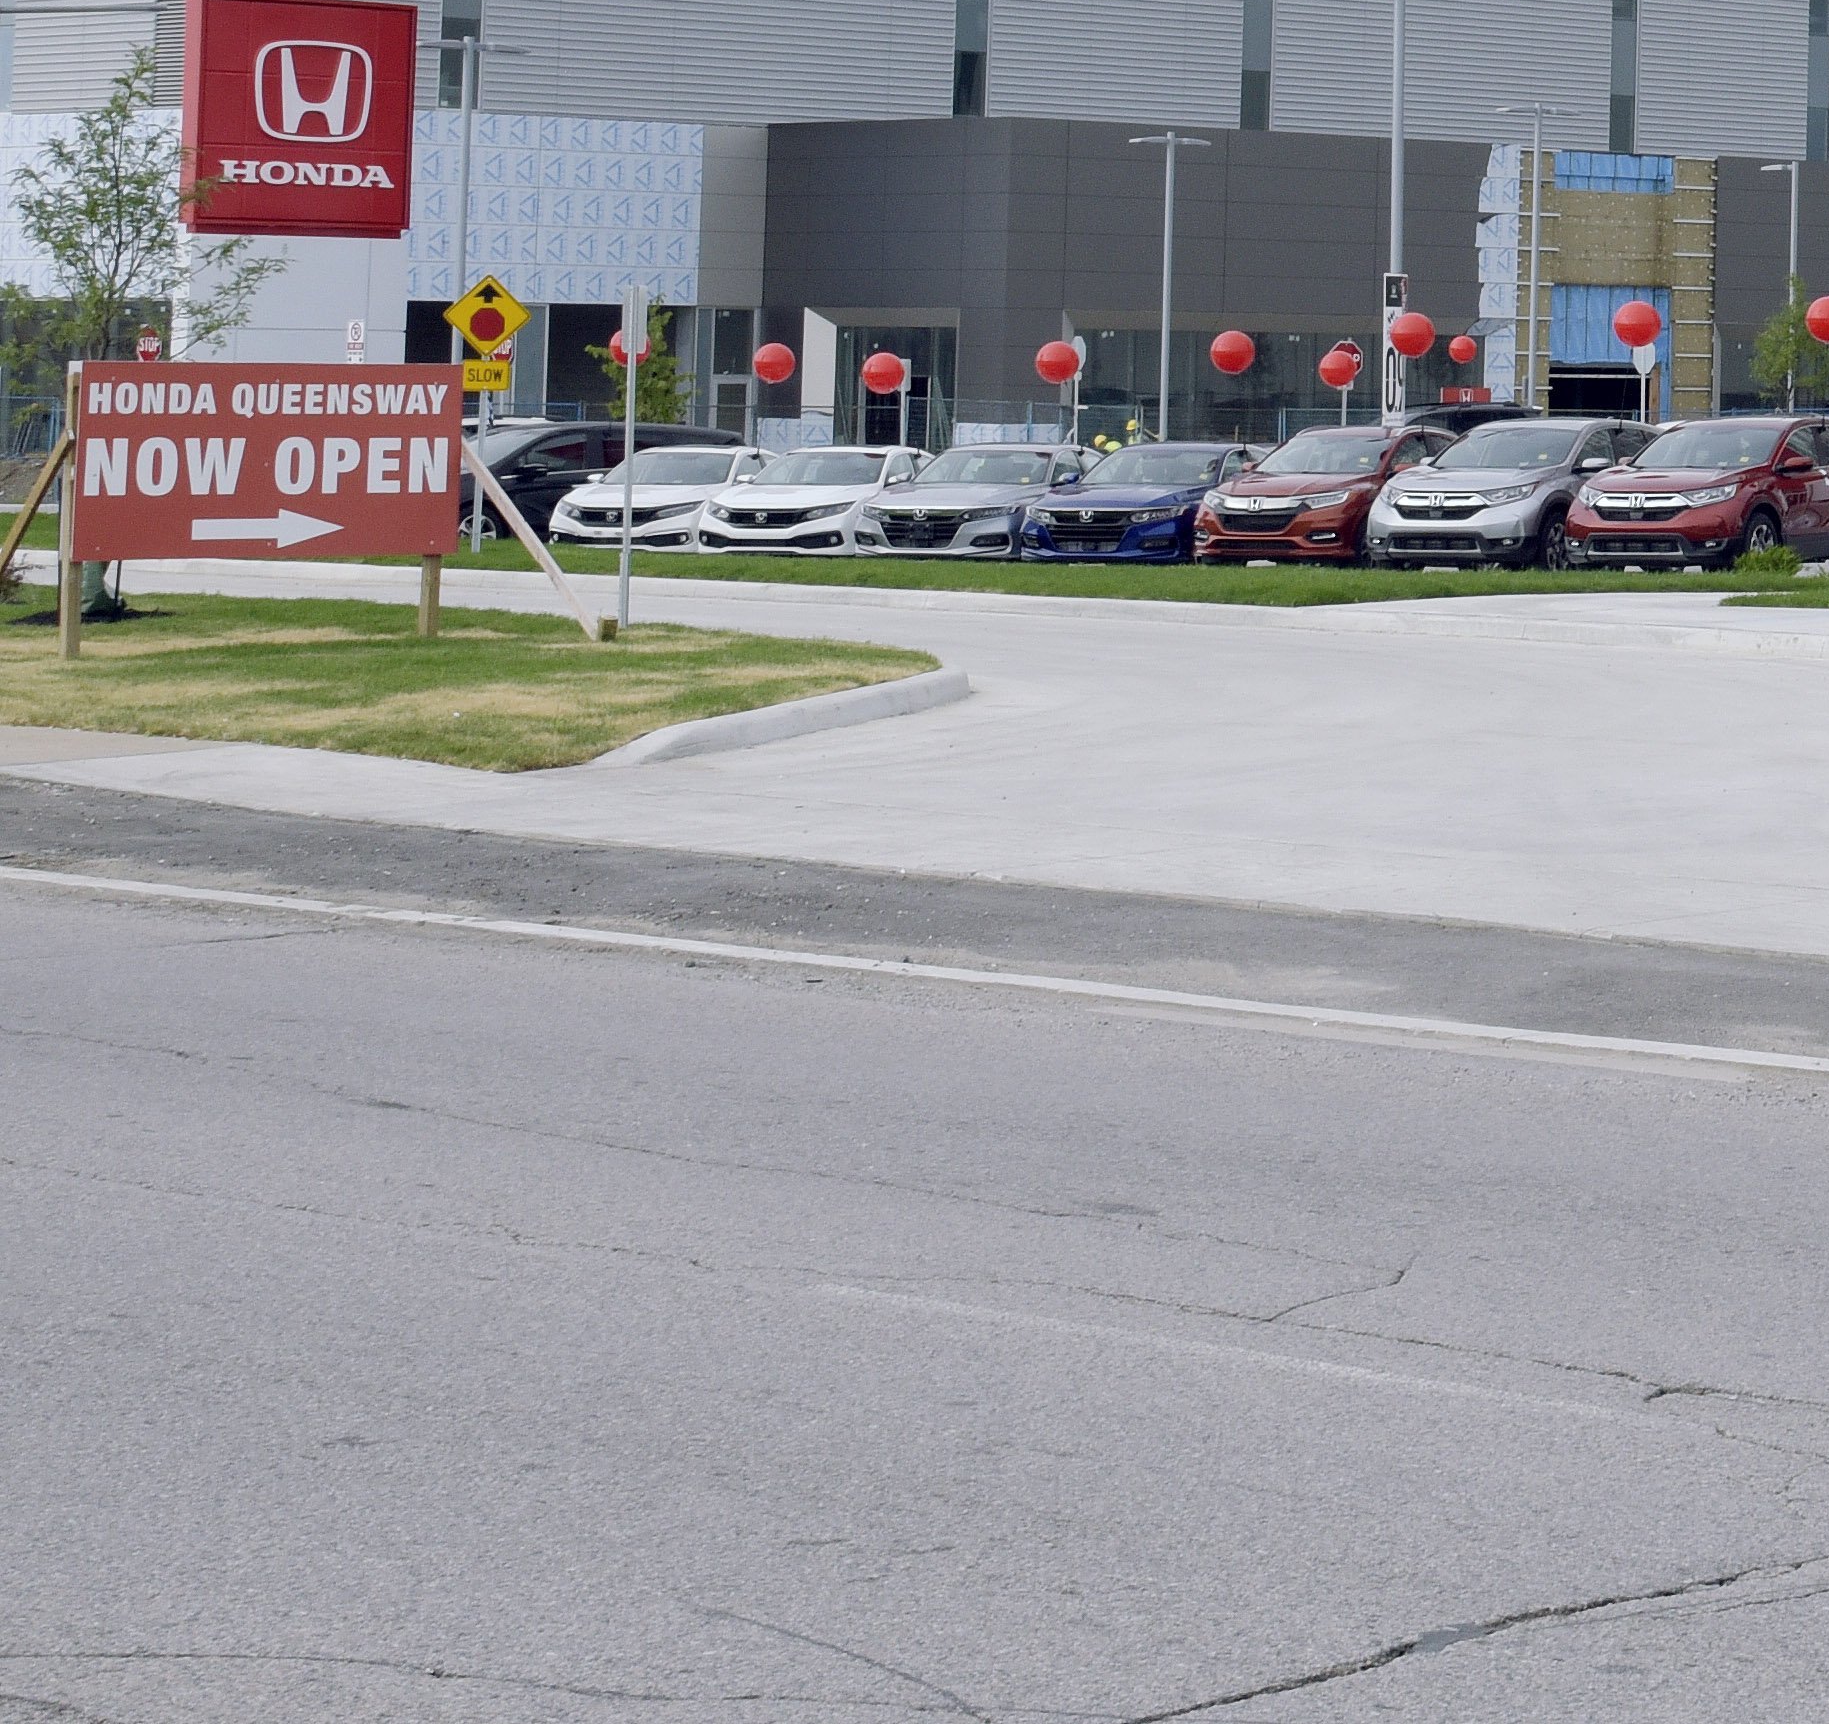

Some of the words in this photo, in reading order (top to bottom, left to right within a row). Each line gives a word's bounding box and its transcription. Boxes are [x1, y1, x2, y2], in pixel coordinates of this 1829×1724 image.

[219, 160, 395, 188] HONDA
[137, 336, 161, 353] STOP
[468, 368, 503, 383] SLOW
[87, 382, 217, 416] HONDA
[231, 382, 449, 418] QUEENSWAY
[83, 437, 247, 497] NOW
[273, 436, 450, 495] OPEN
